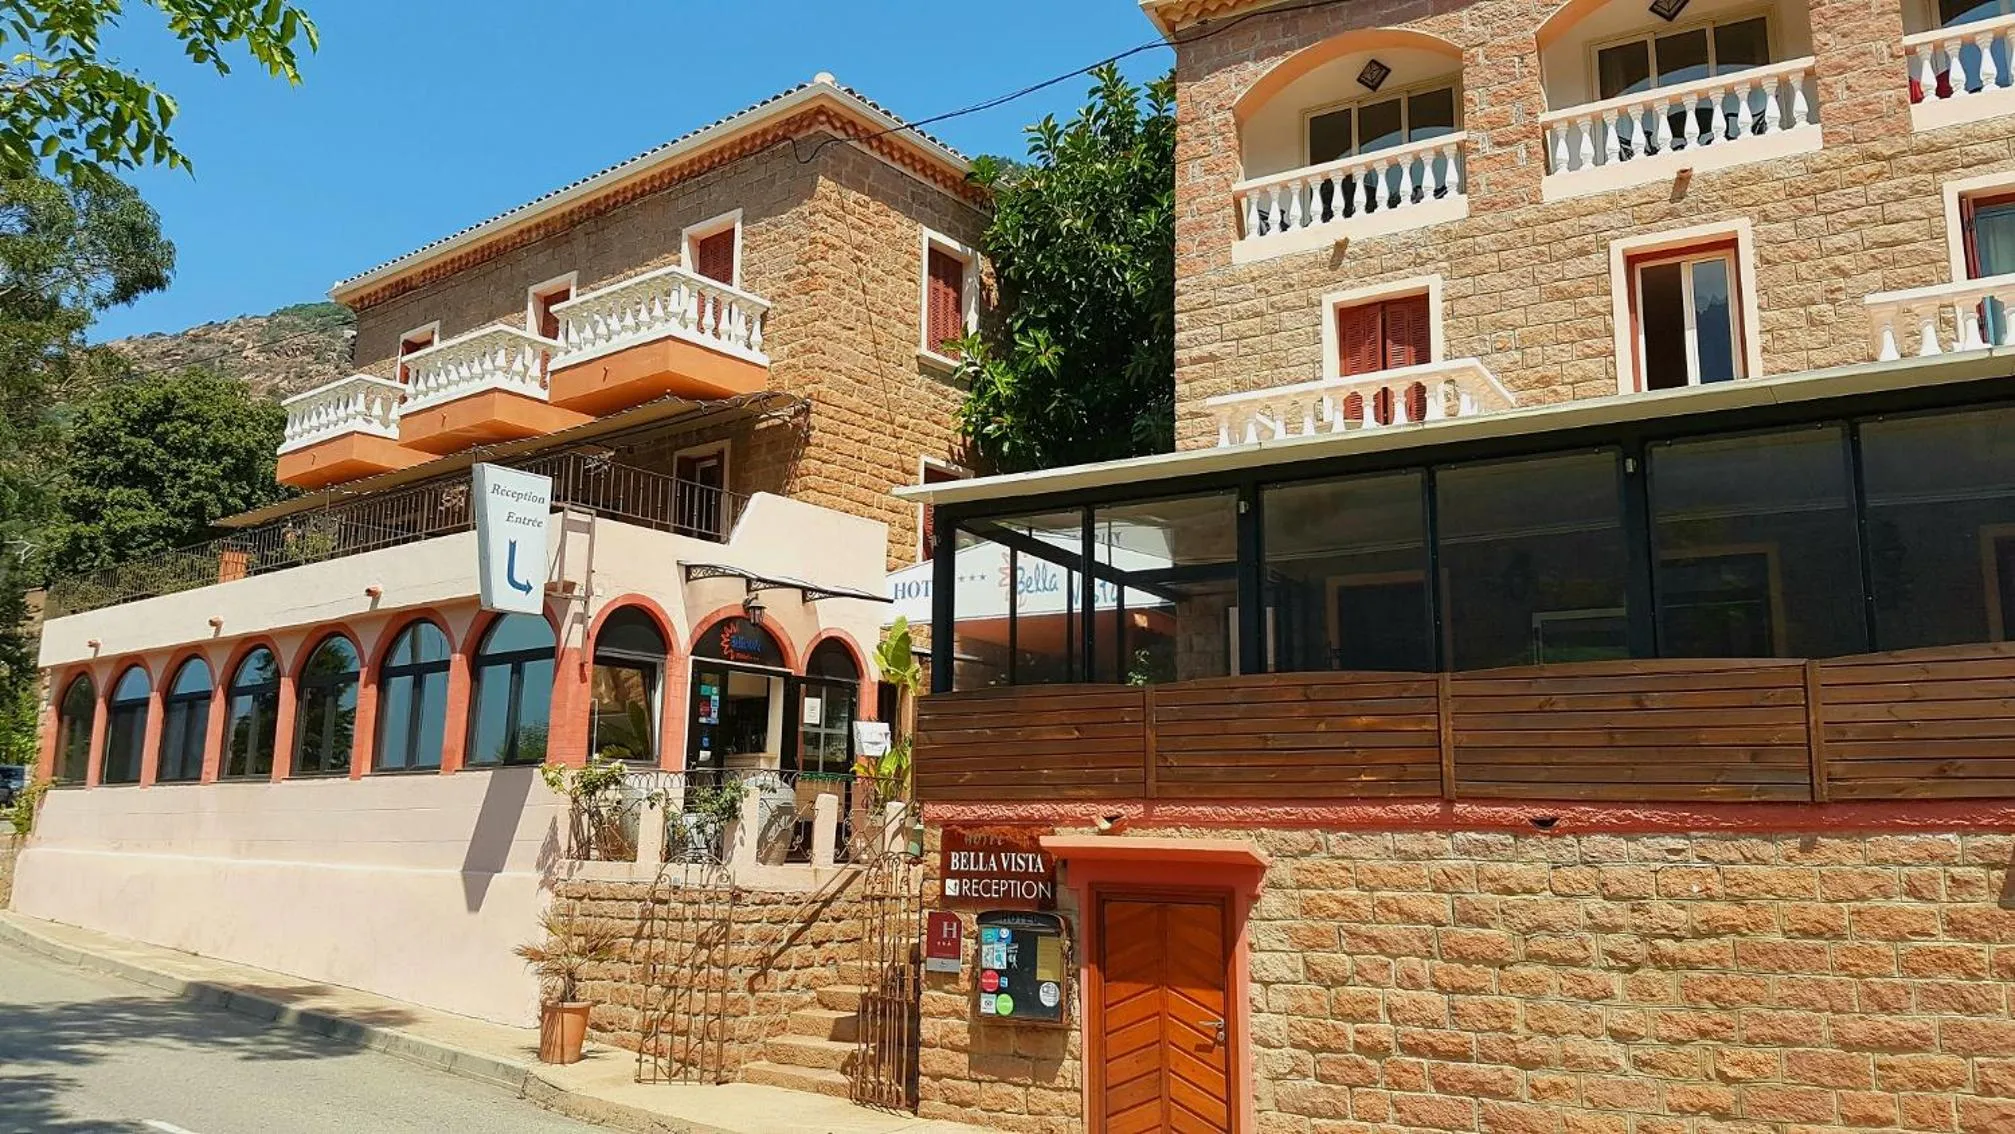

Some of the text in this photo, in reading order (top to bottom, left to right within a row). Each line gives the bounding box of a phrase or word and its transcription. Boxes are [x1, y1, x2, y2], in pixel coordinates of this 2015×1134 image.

[491, 483, 545, 504] Réception
[506, 511, 543, 528] Entrée
[894, 579, 933, 600] HOT
[1016, 562, 1059, 596] Bella
[950, 851, 1045, 873] BELLA VISTA
[962, 878, 1052, 899] RECEPTION
[942, 921, 957, 939] H
